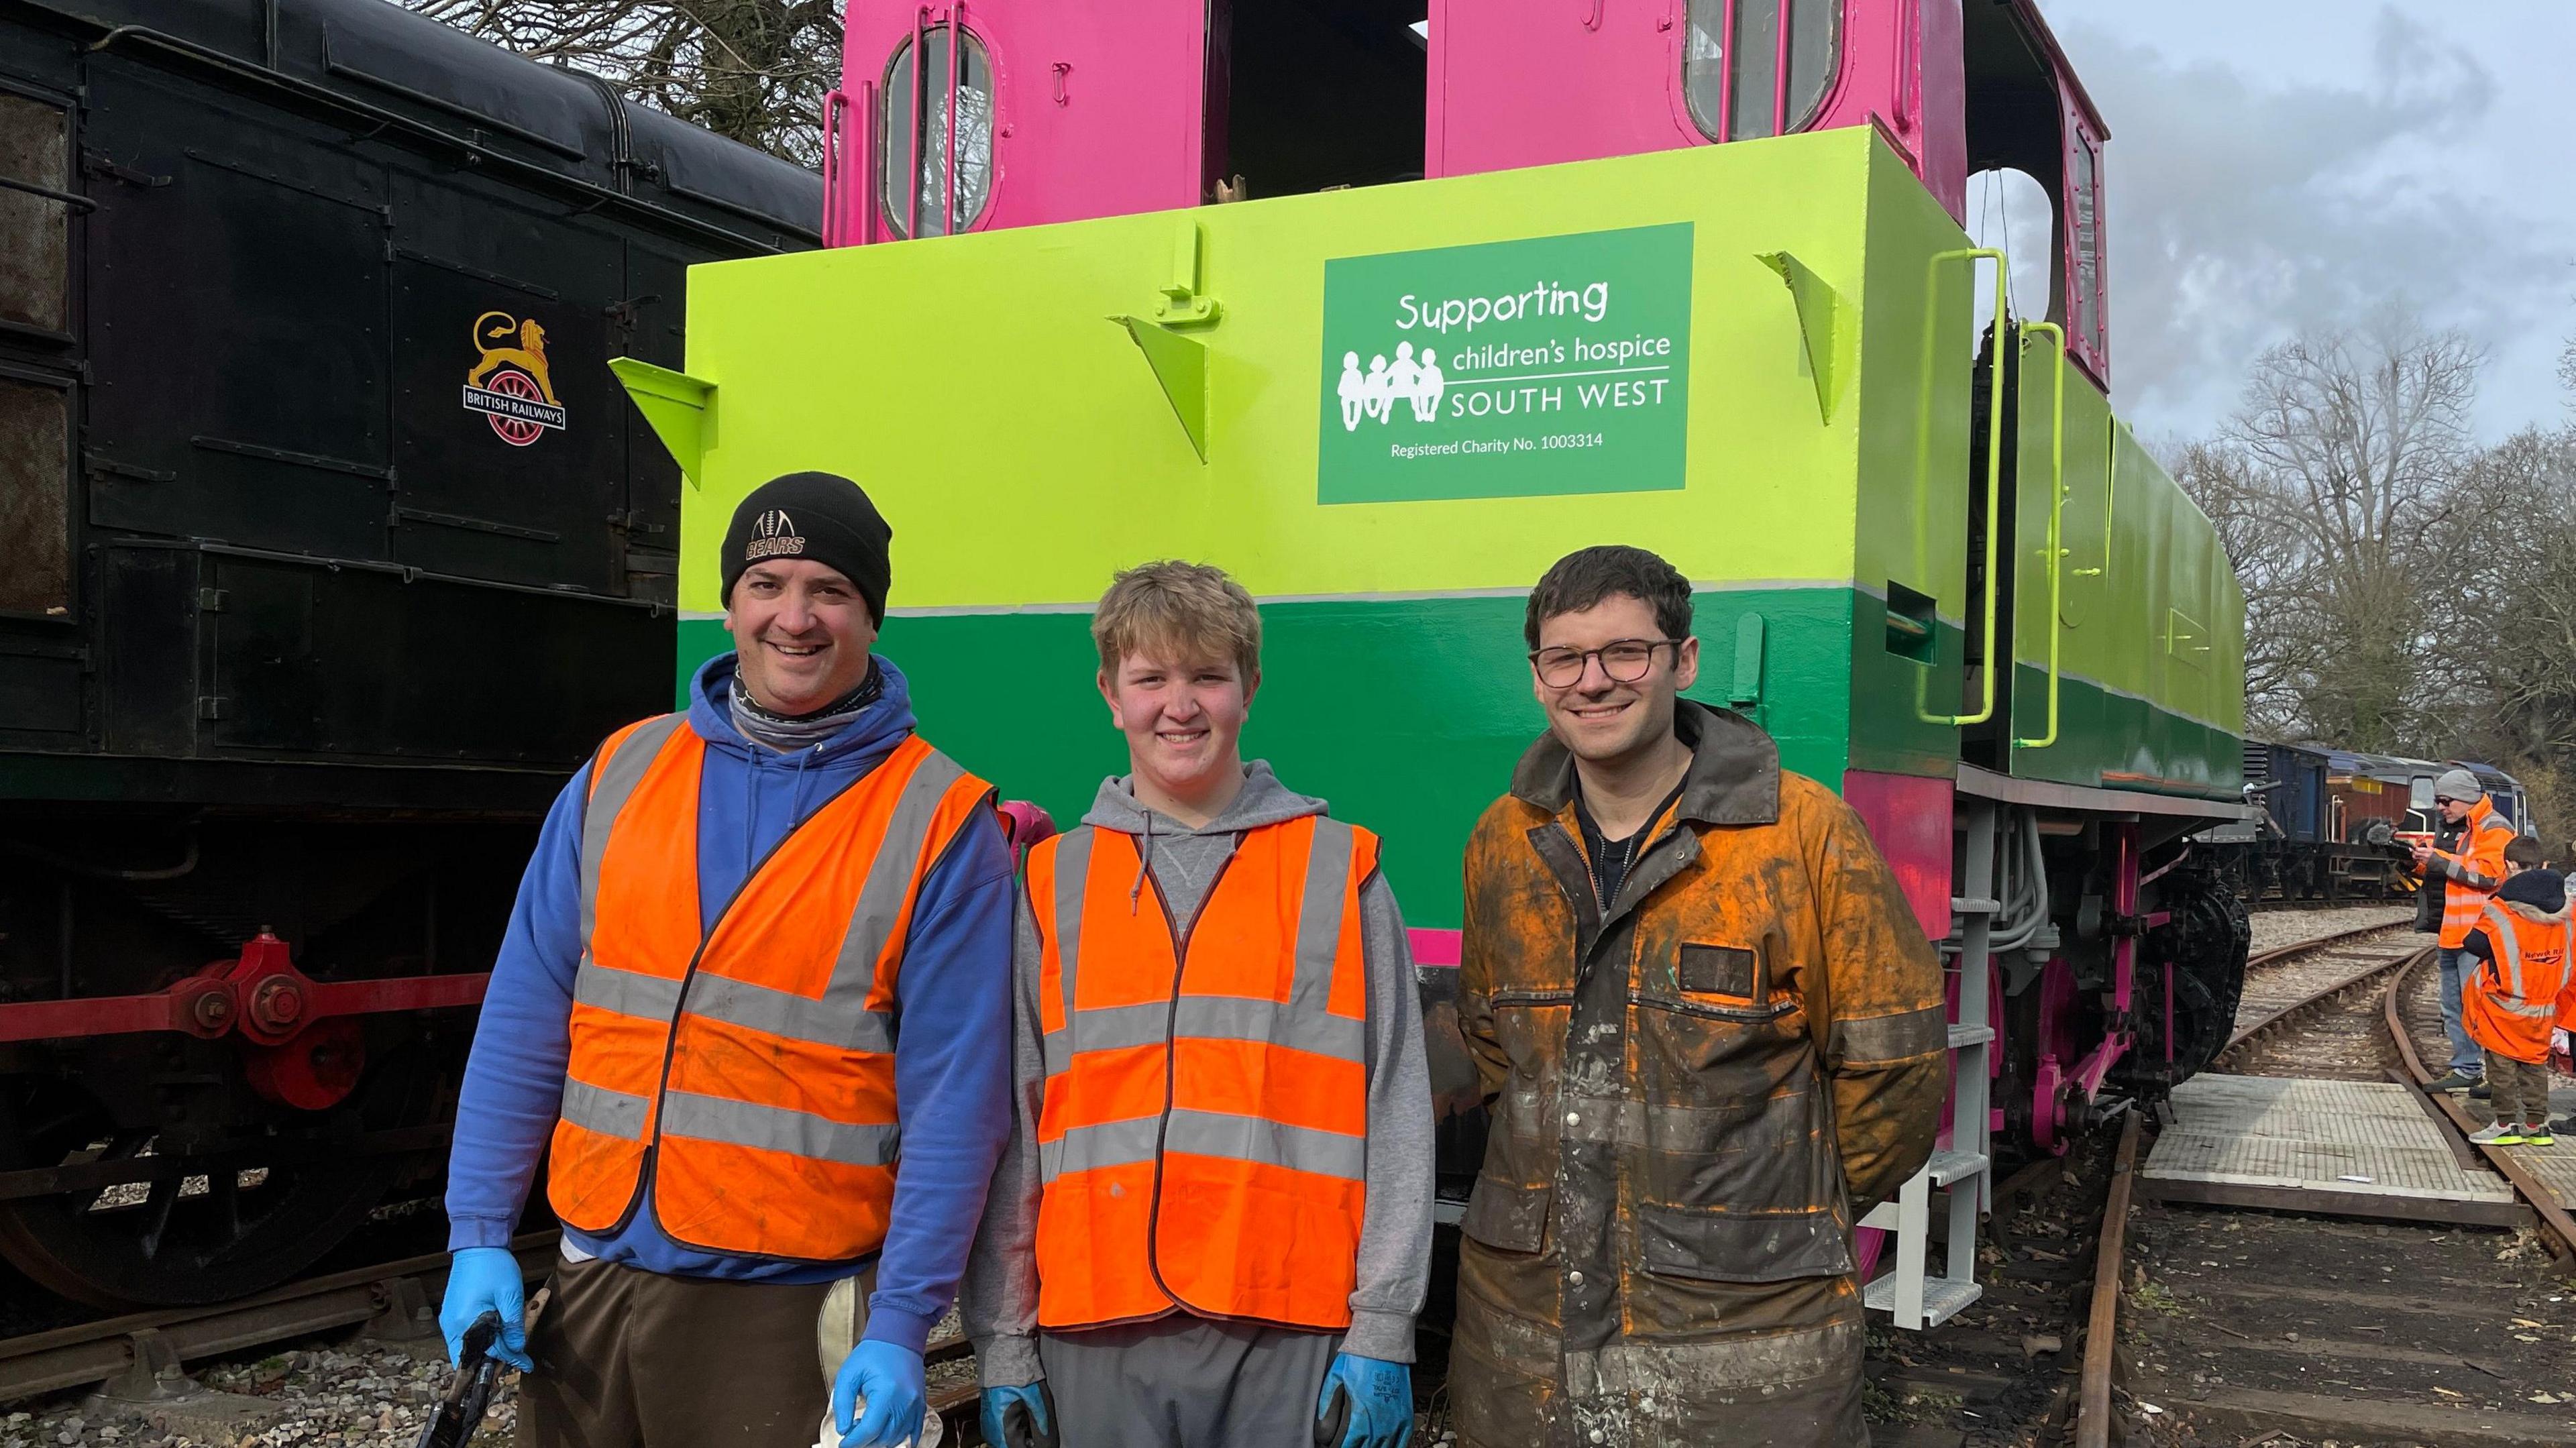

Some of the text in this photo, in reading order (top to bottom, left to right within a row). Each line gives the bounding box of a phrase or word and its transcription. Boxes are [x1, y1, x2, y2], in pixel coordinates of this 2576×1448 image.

[1395, 281, 1608, 334] Supporting
[1453, 334, 1670, 371] children's hospice
[467, 391, 562, 424] BRITISH RAILWAYS
[1452, 379, 1670, 417] SOUTH WEST
[1391, 433, 1603, 459] Registered Charity No. 1003314
[746, 536, 805, 561] BEARS
